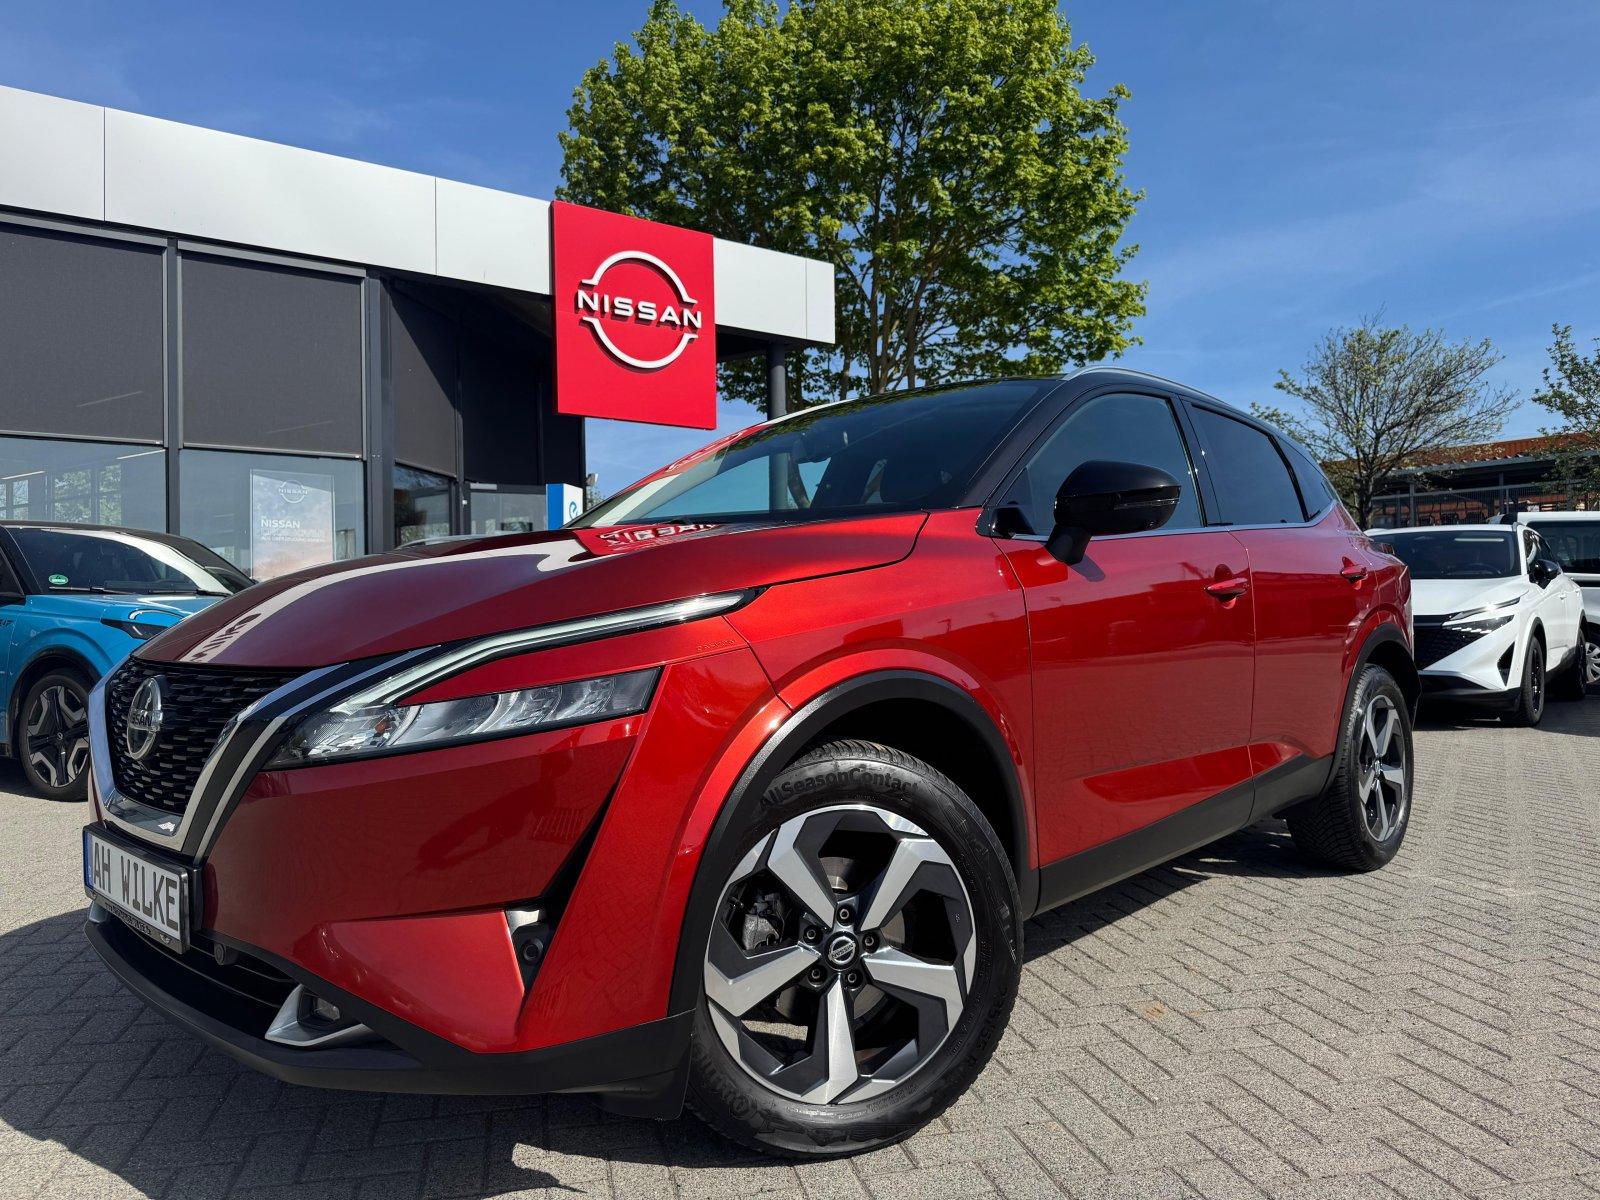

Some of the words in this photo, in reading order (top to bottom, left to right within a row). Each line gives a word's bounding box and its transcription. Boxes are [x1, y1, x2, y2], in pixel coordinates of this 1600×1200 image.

[576, 289, 702, 329] NISSAN
[260, 519, 300, 529] NISSAN
[760, 767, 919, 809] AllSeasonContact
[93, 842, 112, 894] AH
[120, 855, 179, 932] WILKE
